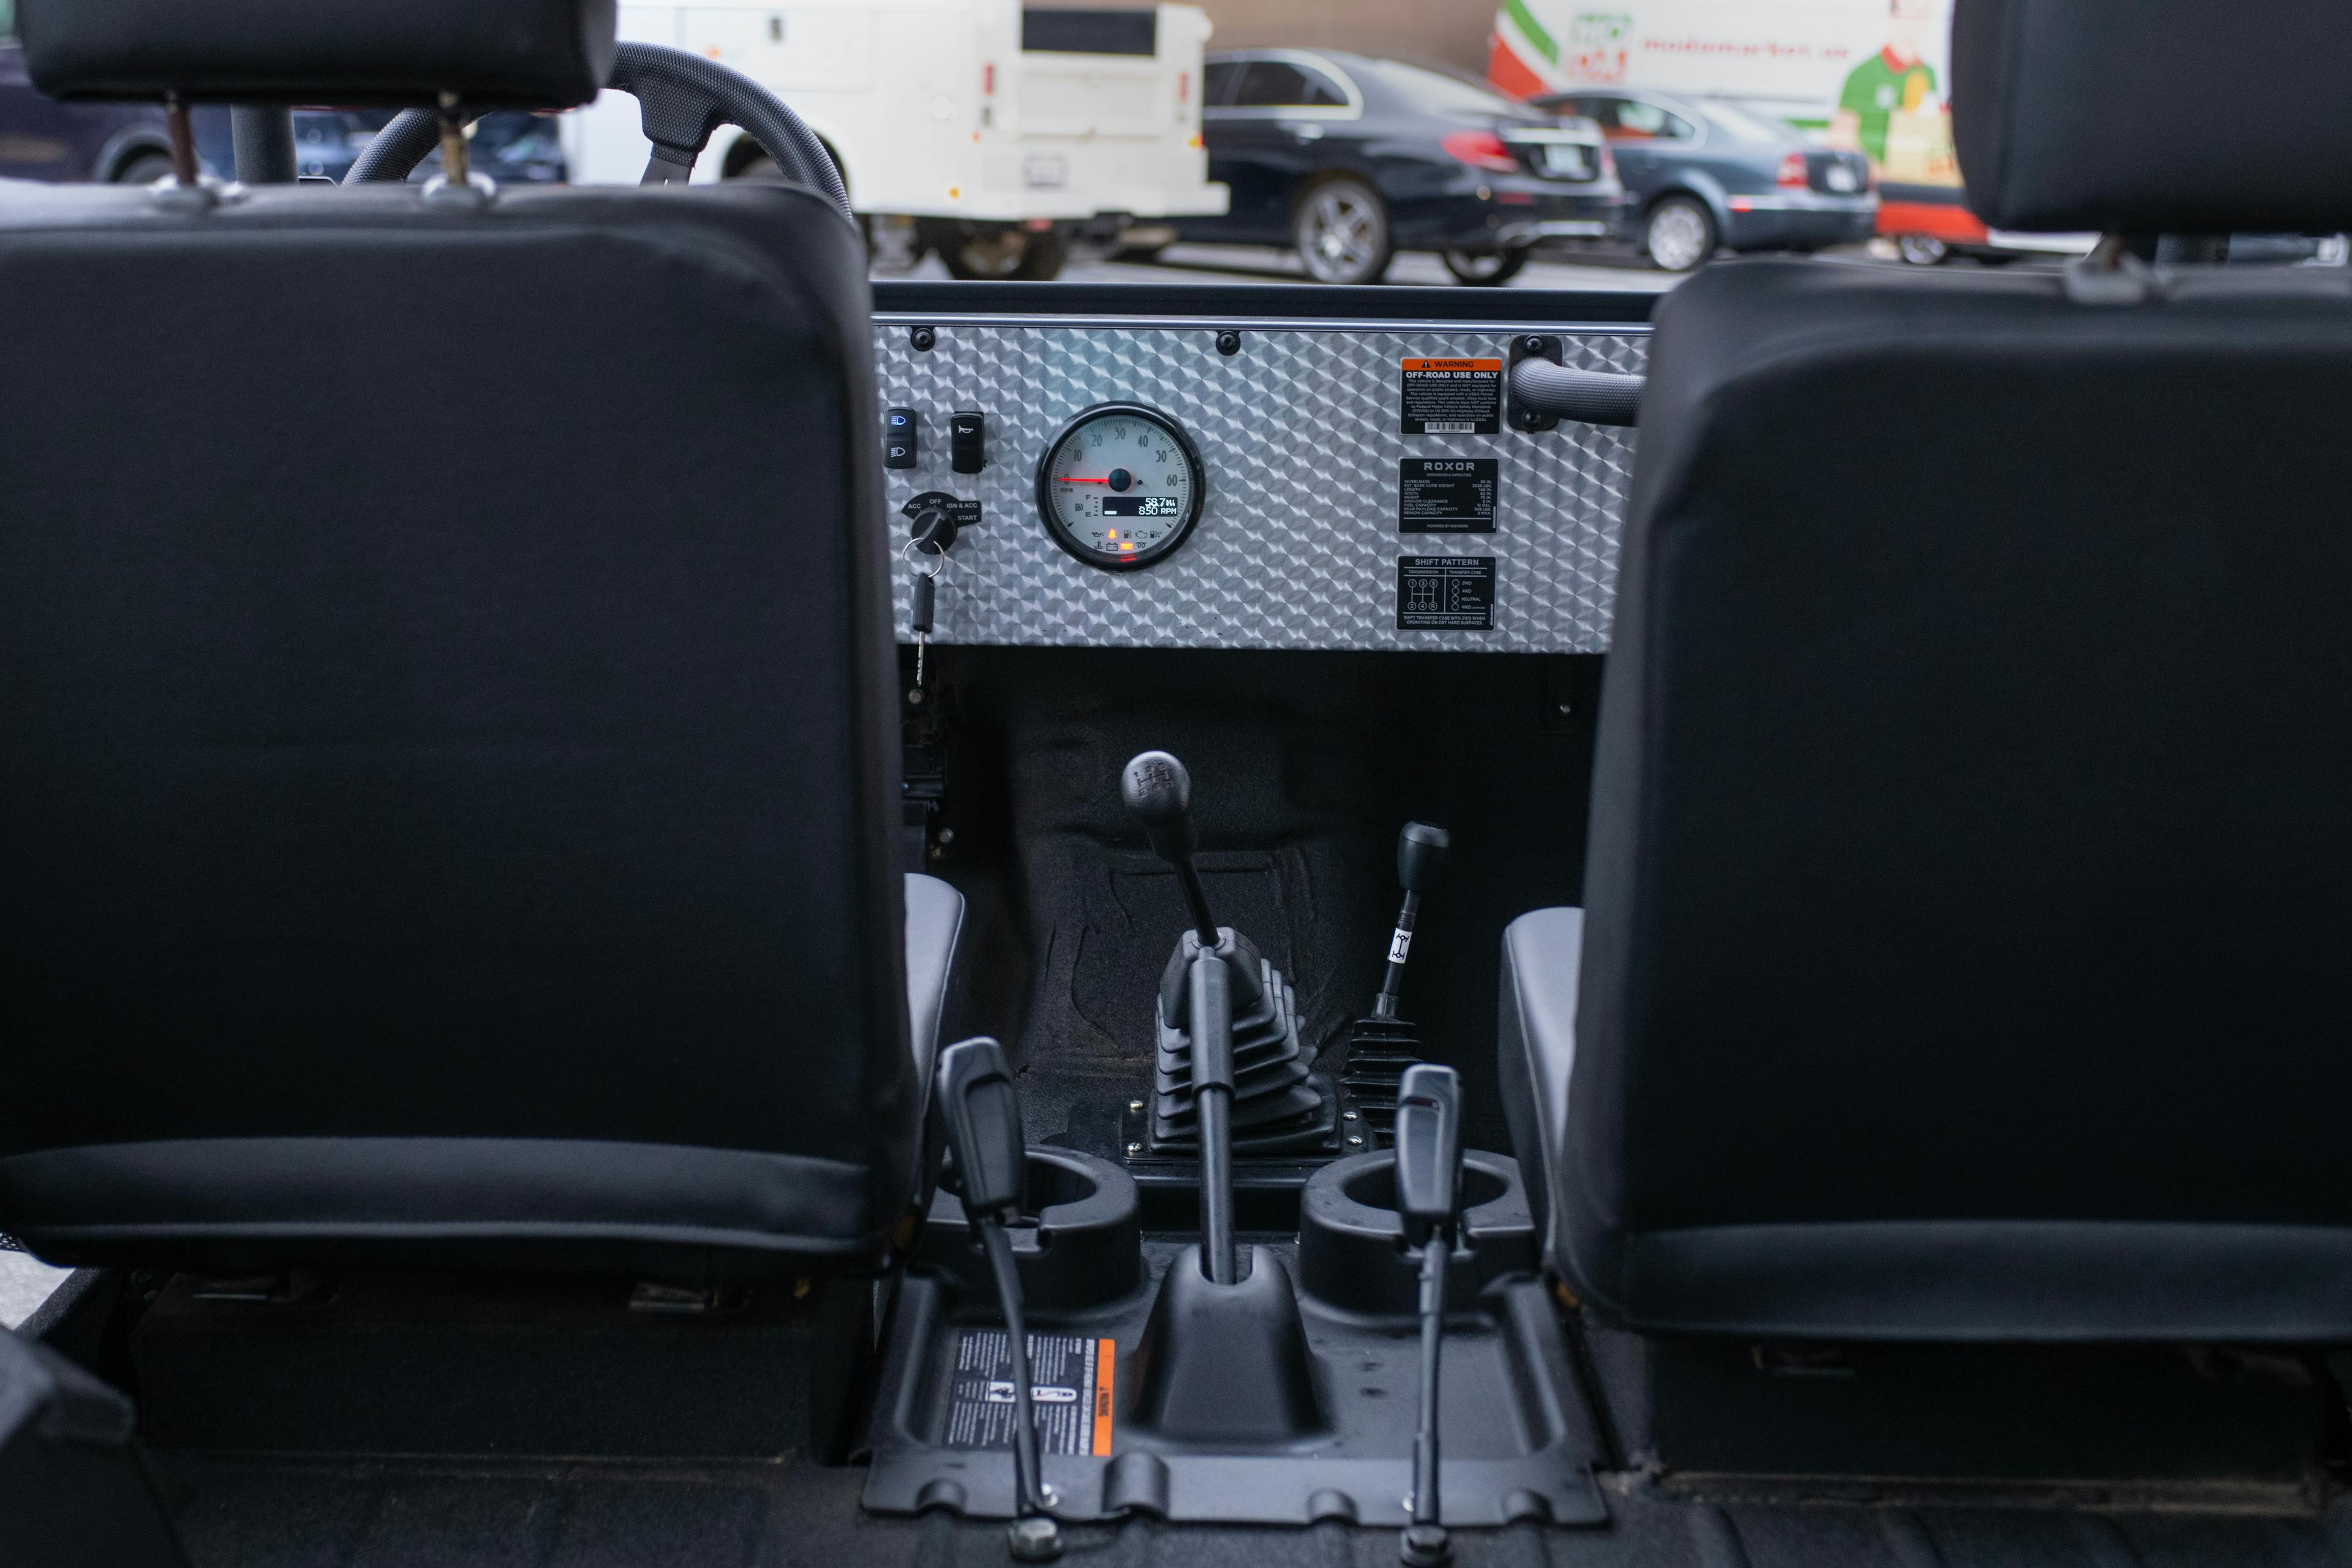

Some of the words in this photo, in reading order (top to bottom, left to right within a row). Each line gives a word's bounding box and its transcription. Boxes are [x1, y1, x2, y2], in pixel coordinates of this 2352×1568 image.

[1115, 427, 1126, 439] 30
[1091, 435, 1102, 447] 20
[1138, 435, 1148, 447] 40
[1074, 450, 1082, 462] 10
[1156, 450, 1167, 462] 50
[1424, 462, 1475, 471] ROXOR
[1167, 474, 1177, 486] 60
[1139, 507, 1158, 515] 850
